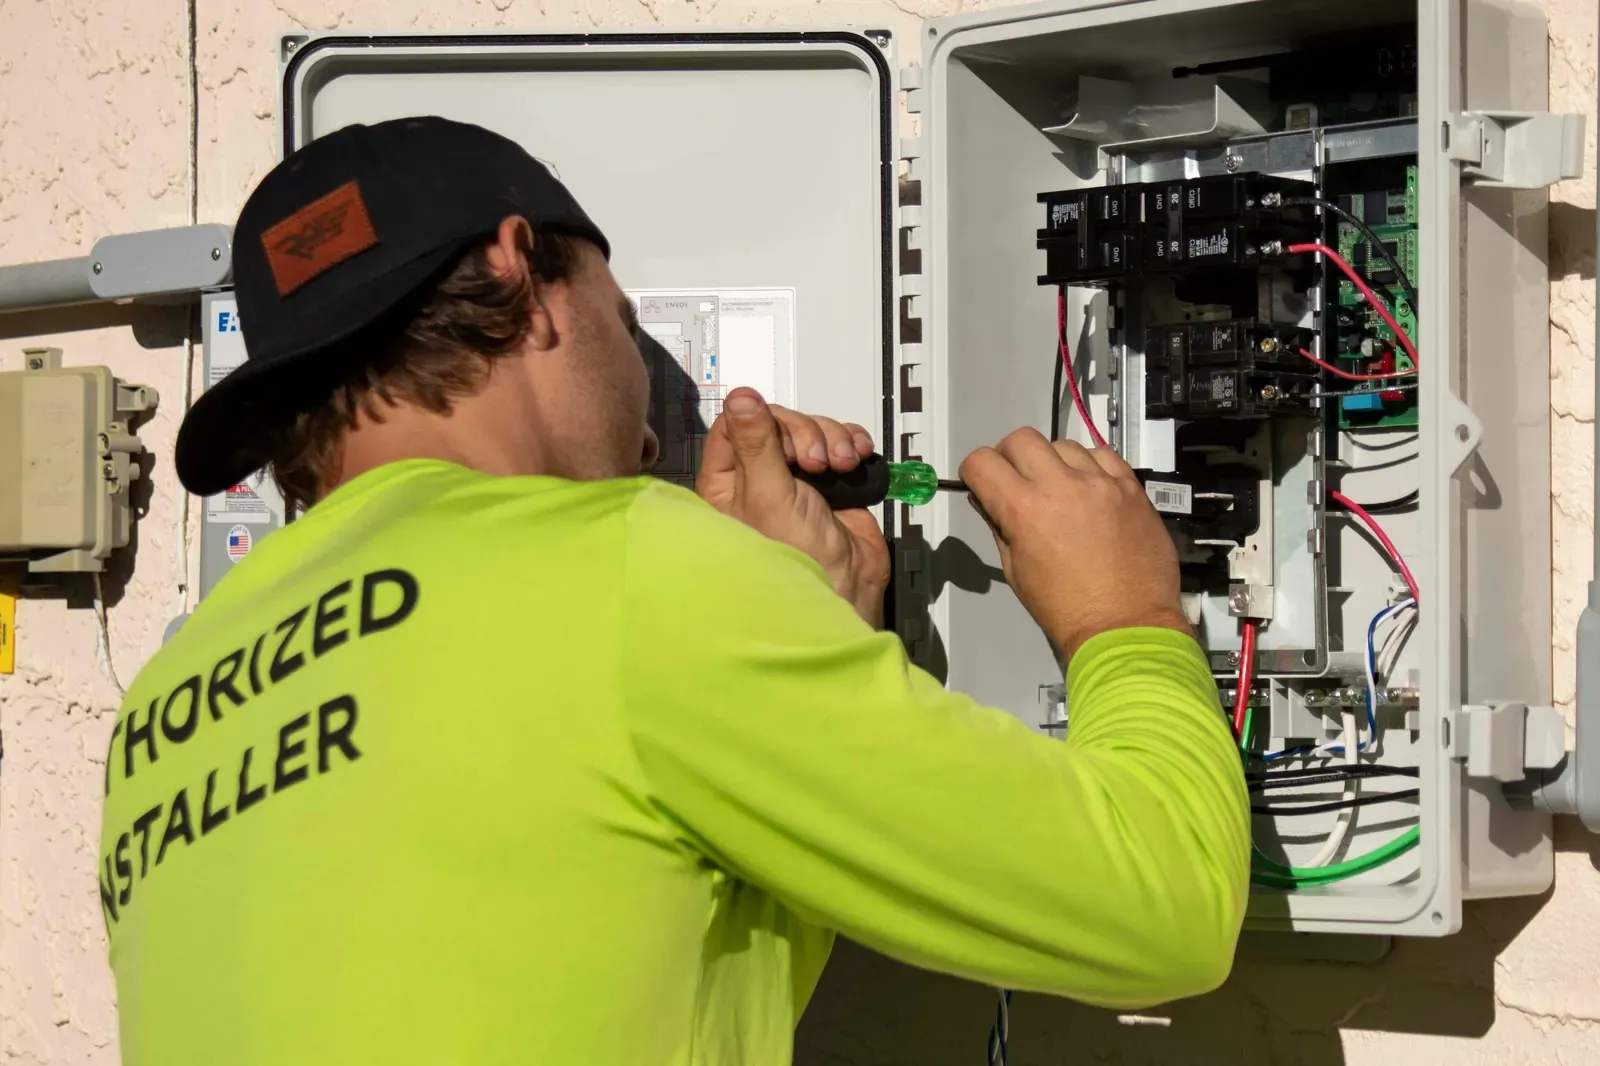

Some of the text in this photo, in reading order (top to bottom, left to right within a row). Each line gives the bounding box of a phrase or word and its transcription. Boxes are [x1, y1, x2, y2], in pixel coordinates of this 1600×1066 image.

[1171, 193, 1179, 204] 20
[1171, 241, 1179, 252] 20
[665, 301, 689, 309] ENVOY
[1172, 336, 1181, 348] 15
[1173, 384, 1181, 395] 15
